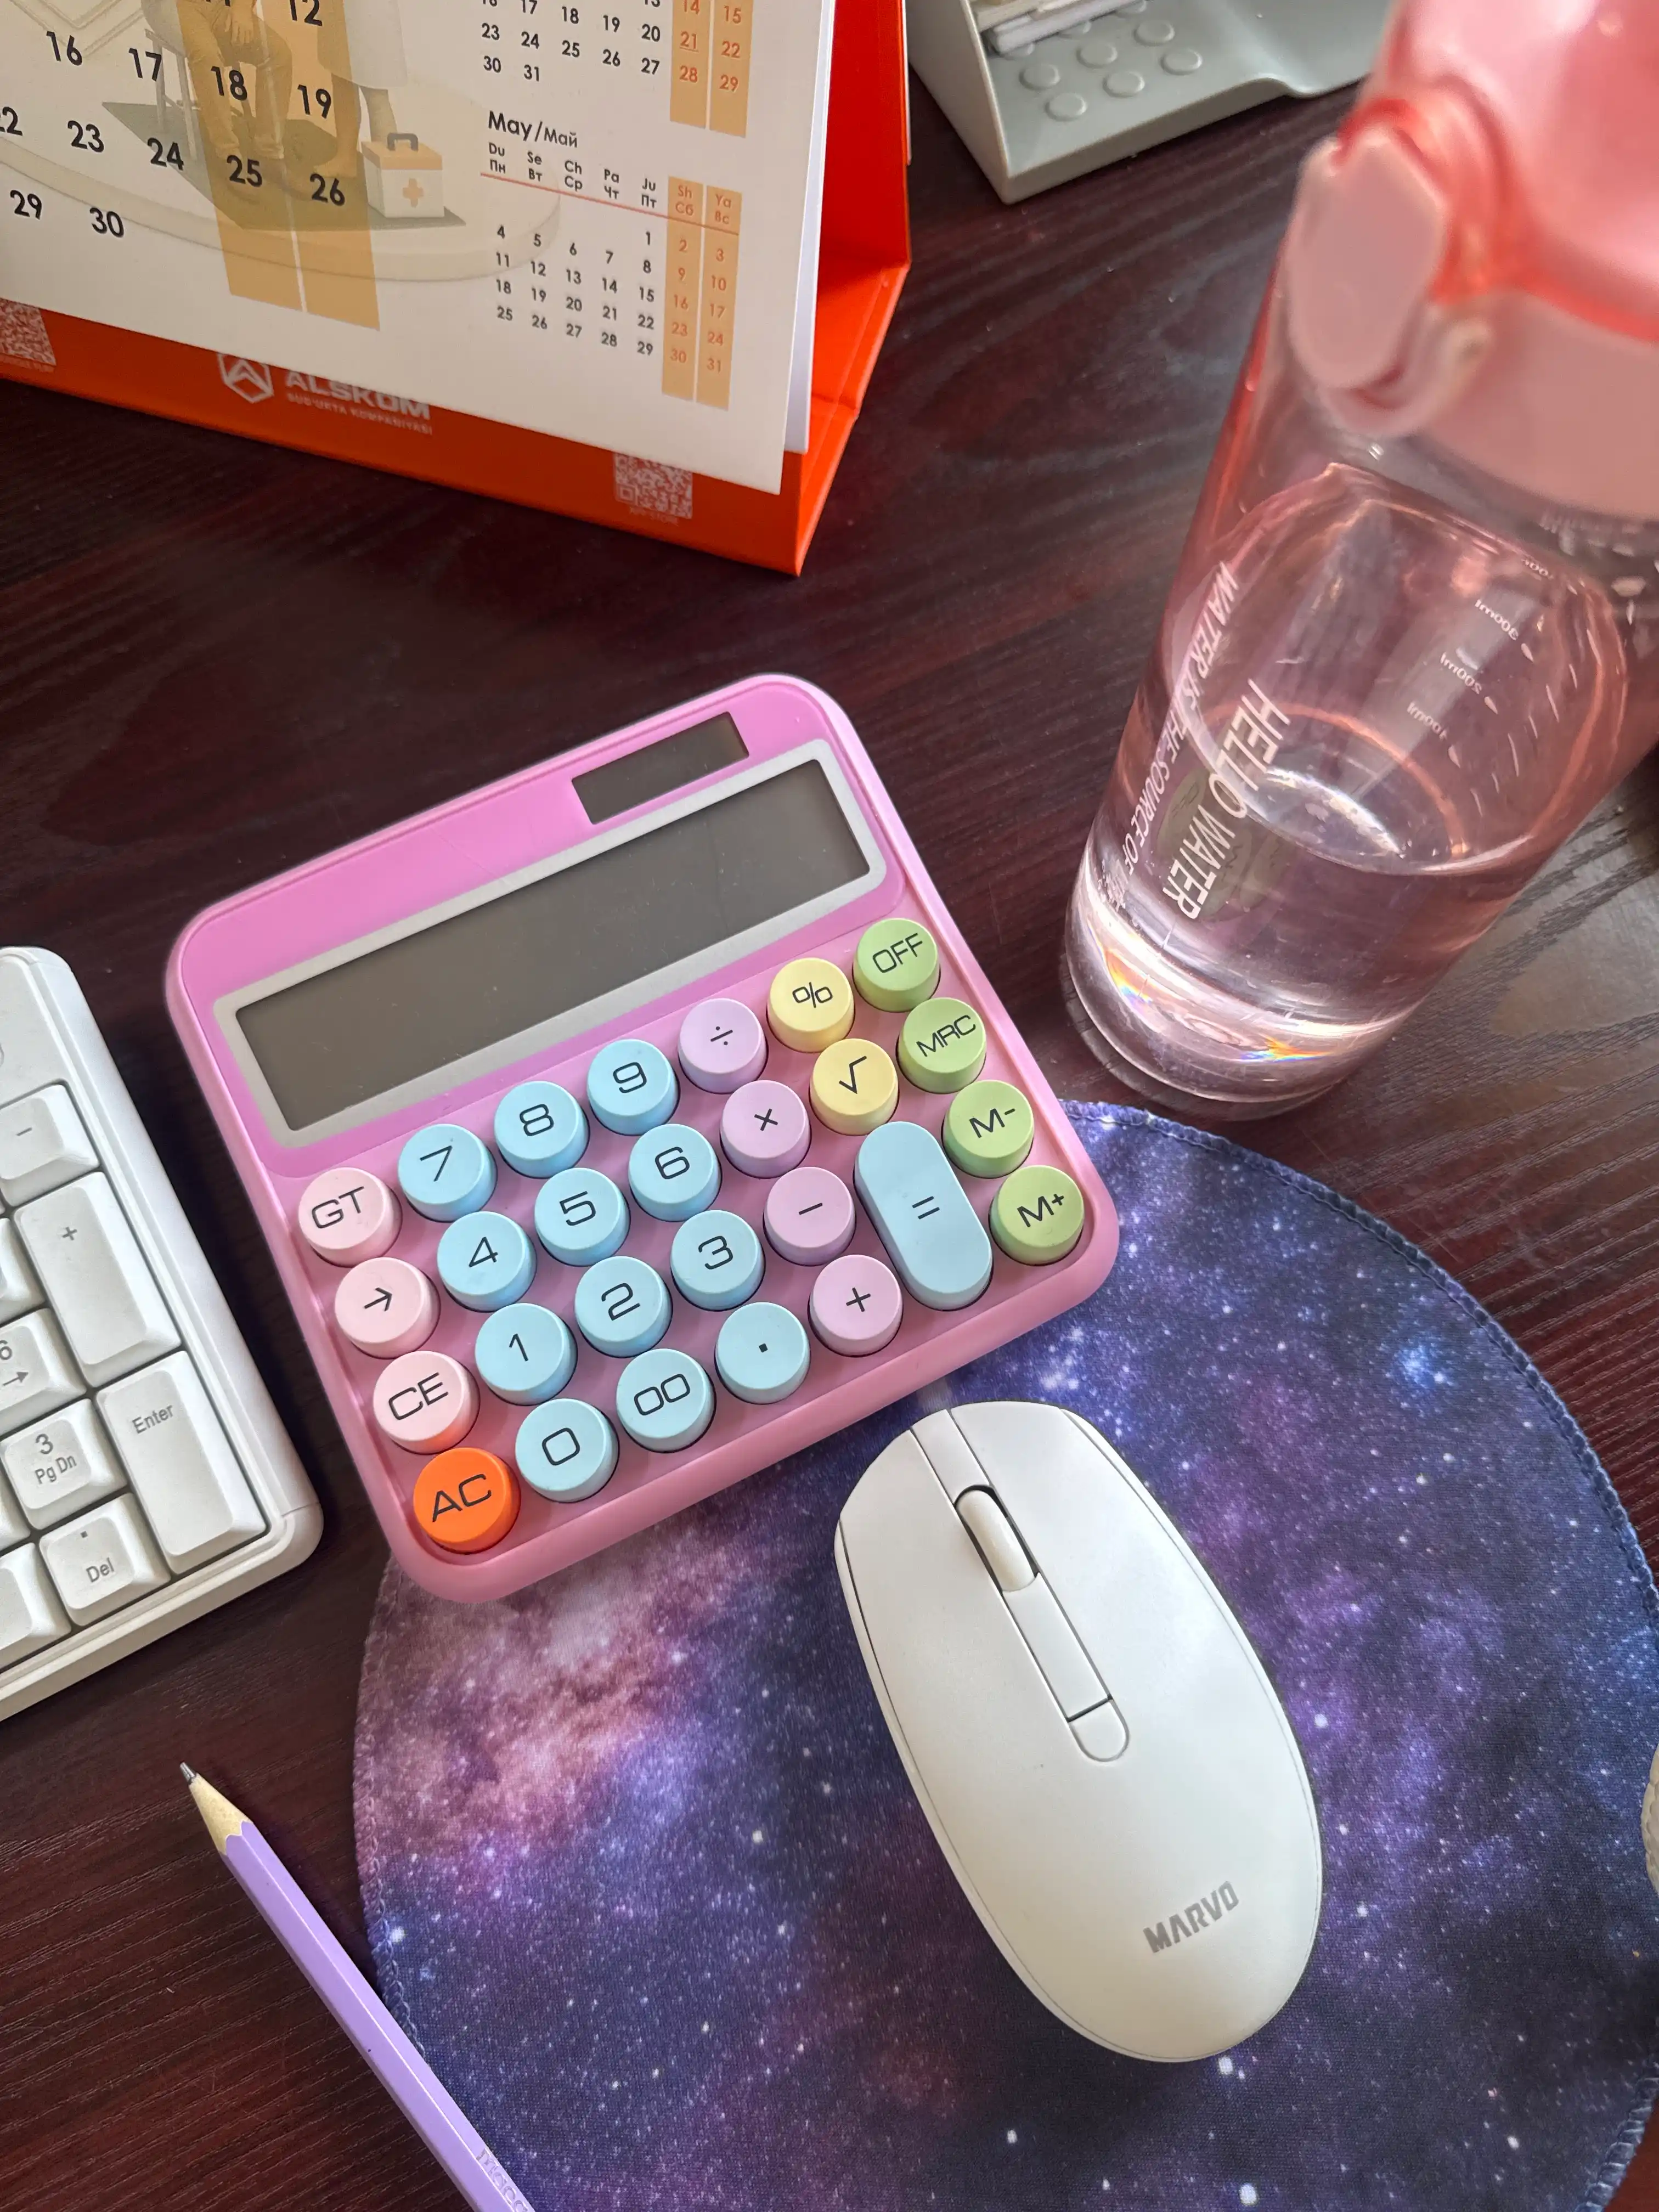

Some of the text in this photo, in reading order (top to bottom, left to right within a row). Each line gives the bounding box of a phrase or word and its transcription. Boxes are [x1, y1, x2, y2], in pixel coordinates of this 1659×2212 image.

[289, 0, 323, 26] 12
[522, 0, 740, 59] 17 18 19 20 21 22
[684, 0, 741, 24] 14 15
[46, 31, 331, 119] 16 17 18 19
[482, 22, 738, 92] 23 24 25 26 27 28 29
[483, 55, 539, 82] 30 31
[67, 120, 104, 153] 23
[147, 137, 184, 171] 24
[227, 155, 262, 187] 25
[309, 173, 345, 206] 26
[489, 142, 732, 208] Du Se Ch Pa Ju Sh Ya
[490, 159, 506, 174] Пн
[528, 168, 543, 182] Вт
[565, 175, 583, 191] Ср
[604, 185, 619, 200] Чт
[641, 194, 657, 208] Пт
[10, 190, 124, 238] 29 30
[497, 225, 726, 291] 4 5 6 7 8 9 10
[646, 232, 724, 262] 1 2 3
[496, 252, 725, 318] 11 12 13 14 15 16 17
[496, 279, 723, 346] 18 19 20 21 22 23 24
[497, 305, 721, 373] 25 26 27 28 29 30 31
[1189, 561, 1239, 680] WATER
[1131, 750, 1170, 848] SOURCE
[1163, 678, 1290, 919] HELLO WATER
[1122, 833, 1138, 876] OF
[872, 933, 923, 973] OFF
[916, 1014, 976, 1057] MRC
[613, 1062, 647, 1093] 9
[519, 1104, 554, 1137] 8
[969, 1108, 1015, 1138] M-
[420, 1145, 453, 1182] 7
[654, 1146, 690, 1180] 6
[312, 1186, 364, 1229] GT
[559, 1190, 596, 1226] 5
[1017, 1193, 1064, 1228] M+
[469, 1237, 499, 1268] 4
[698, 1235, 733, 1270] 3
[601, 1283, 641, 1321] 2
[509, 1333, 529, 1362] 1
[388, 1372, 449, 1420] CE
[634, 1373, 691, 1416] 00
[132, 1405, 173, 1434] Enter
[35, 1434, 54, 1454] 3
[541, 1427, 580, 1466] 0
[34, 1455, 77, 1484] Pg Dn
[432, 1474, 492, 1522] AC
[86, 1557, 115, 1583] Del
[1142, 1885, 1238, 1954] MARVO
